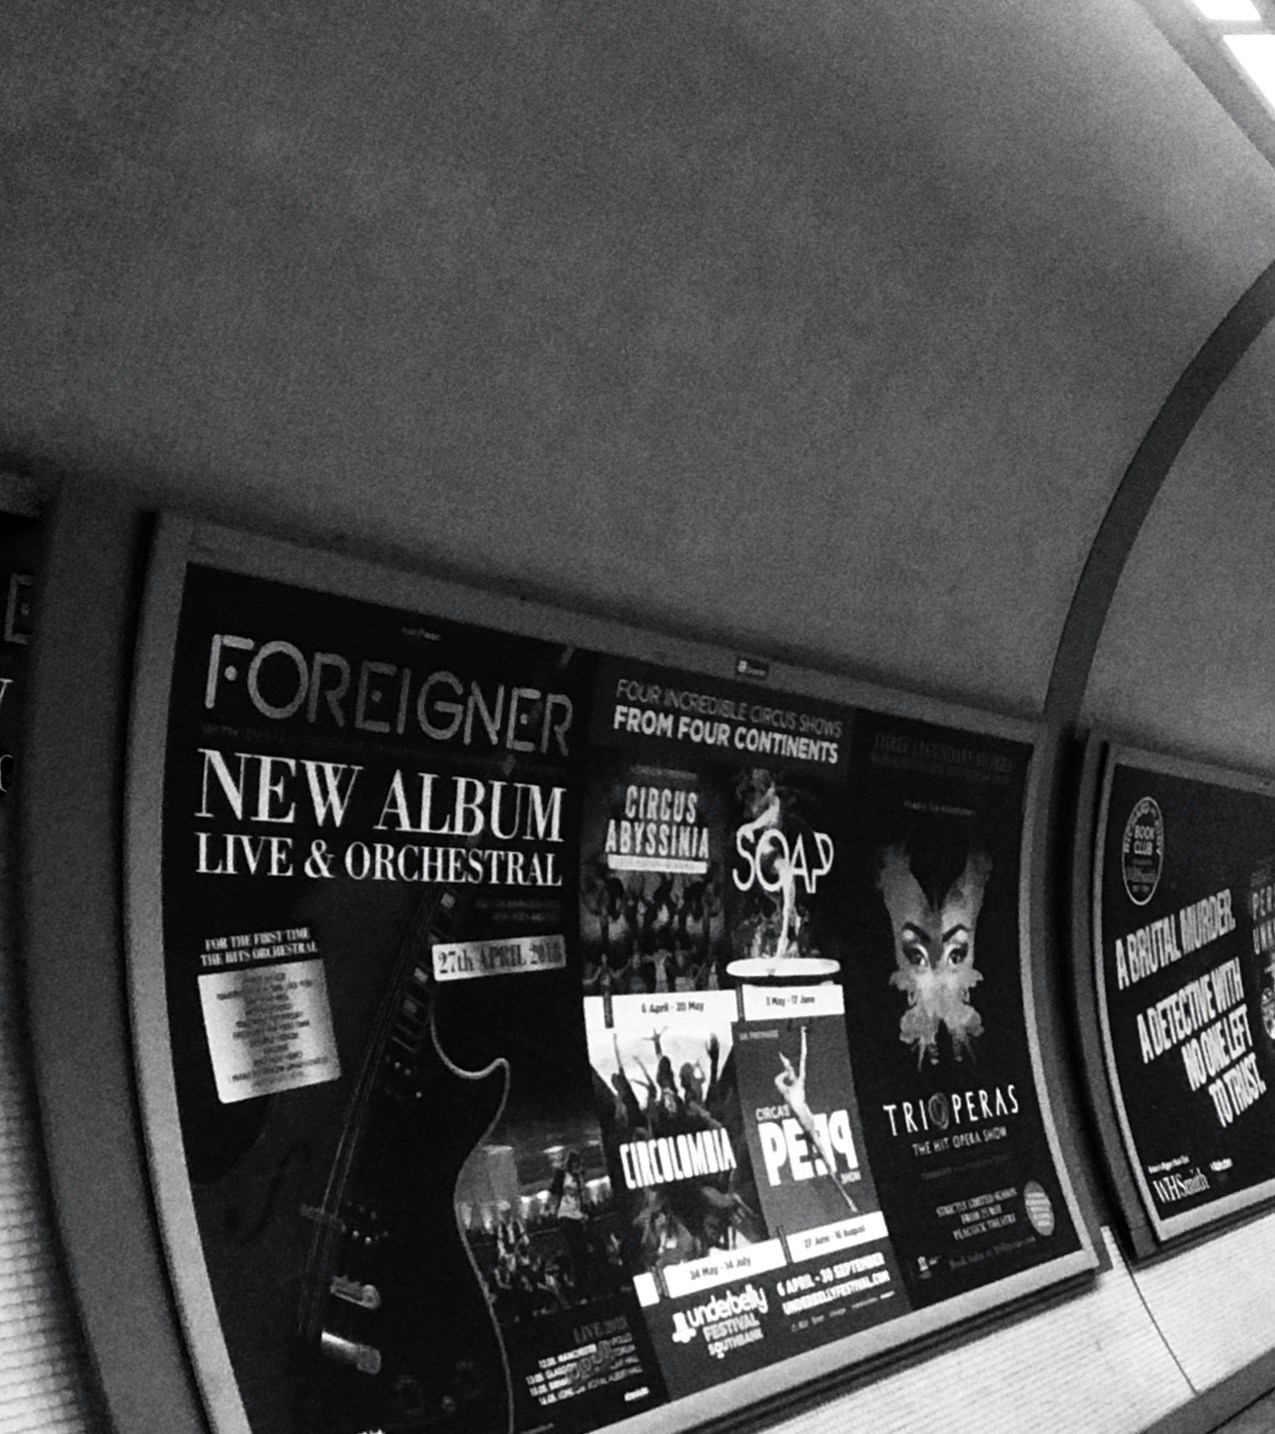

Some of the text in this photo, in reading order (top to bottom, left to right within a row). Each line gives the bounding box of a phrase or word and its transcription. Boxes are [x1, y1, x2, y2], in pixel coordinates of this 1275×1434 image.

[204, 633, 574, 757] FOREIGNER
[616, 678, 842, 739] FOUR INCREDIBLE CIRCUS SHOWS
[613, 704, 674, 738] FROM
[678, 716, 731, 747] FOUR
[734, 726, 838, 764] CONTINENTS
[194, 748, 568, 842] NEW ALBUM
[624, 784, 698, 824] CIRCUS
[604, 818, 709, 859] ABYSSINIA
[1133, 840, 1153, 855] CLUB
[1134, 824, 1154, 839] BOOK
[194, 832, 295, 877] LIVE
[303, 838, 335, 879] &
[344, 840, 563, 887] ORCHESTRAL
[732, 826, 835, 893] SOAP
[200, 940, 319, 967] THE HITS ORCHESTRAL
[204, 926, 310, 952] FOR THE FIRST TIME
[439, 950, 473, 974] 27th
[480, 944, 526, 969] APRIL
[1115, 938, 1130, 991] A
[1126, 914, 1182, 984] BRUTAL
[1179, 888, 1236, 956] MURDER.
[649, 1002, 669, 1014] April
[688, 1001, 704, 1013] May
[1136, 956, 1246, 1065] A DETECTIVE WITH
[1181, 1002, 1253, 1091] NO ONE LEFT
[882, 1084, 1019, 1136] TRIOPERAS
[1208, 1052, 1267, 1128] TO TRUST.
[619, 1127, 737, 1189] CIRCOLOMBIA
[912, 1126, 1007, 1156] THE HIT OPERA SHOW
[1152, 1167, 1210, 1203] WHSmith
[702, 1266, 719, 1277] May
[786, 1273, 816, 1295] APRIL
[833, 1252, 886, 1280] SEPTEMBER
[686, 1283, 769, 1328] underbelly
[702, 1313, 761, 1342] FESTIVAL
